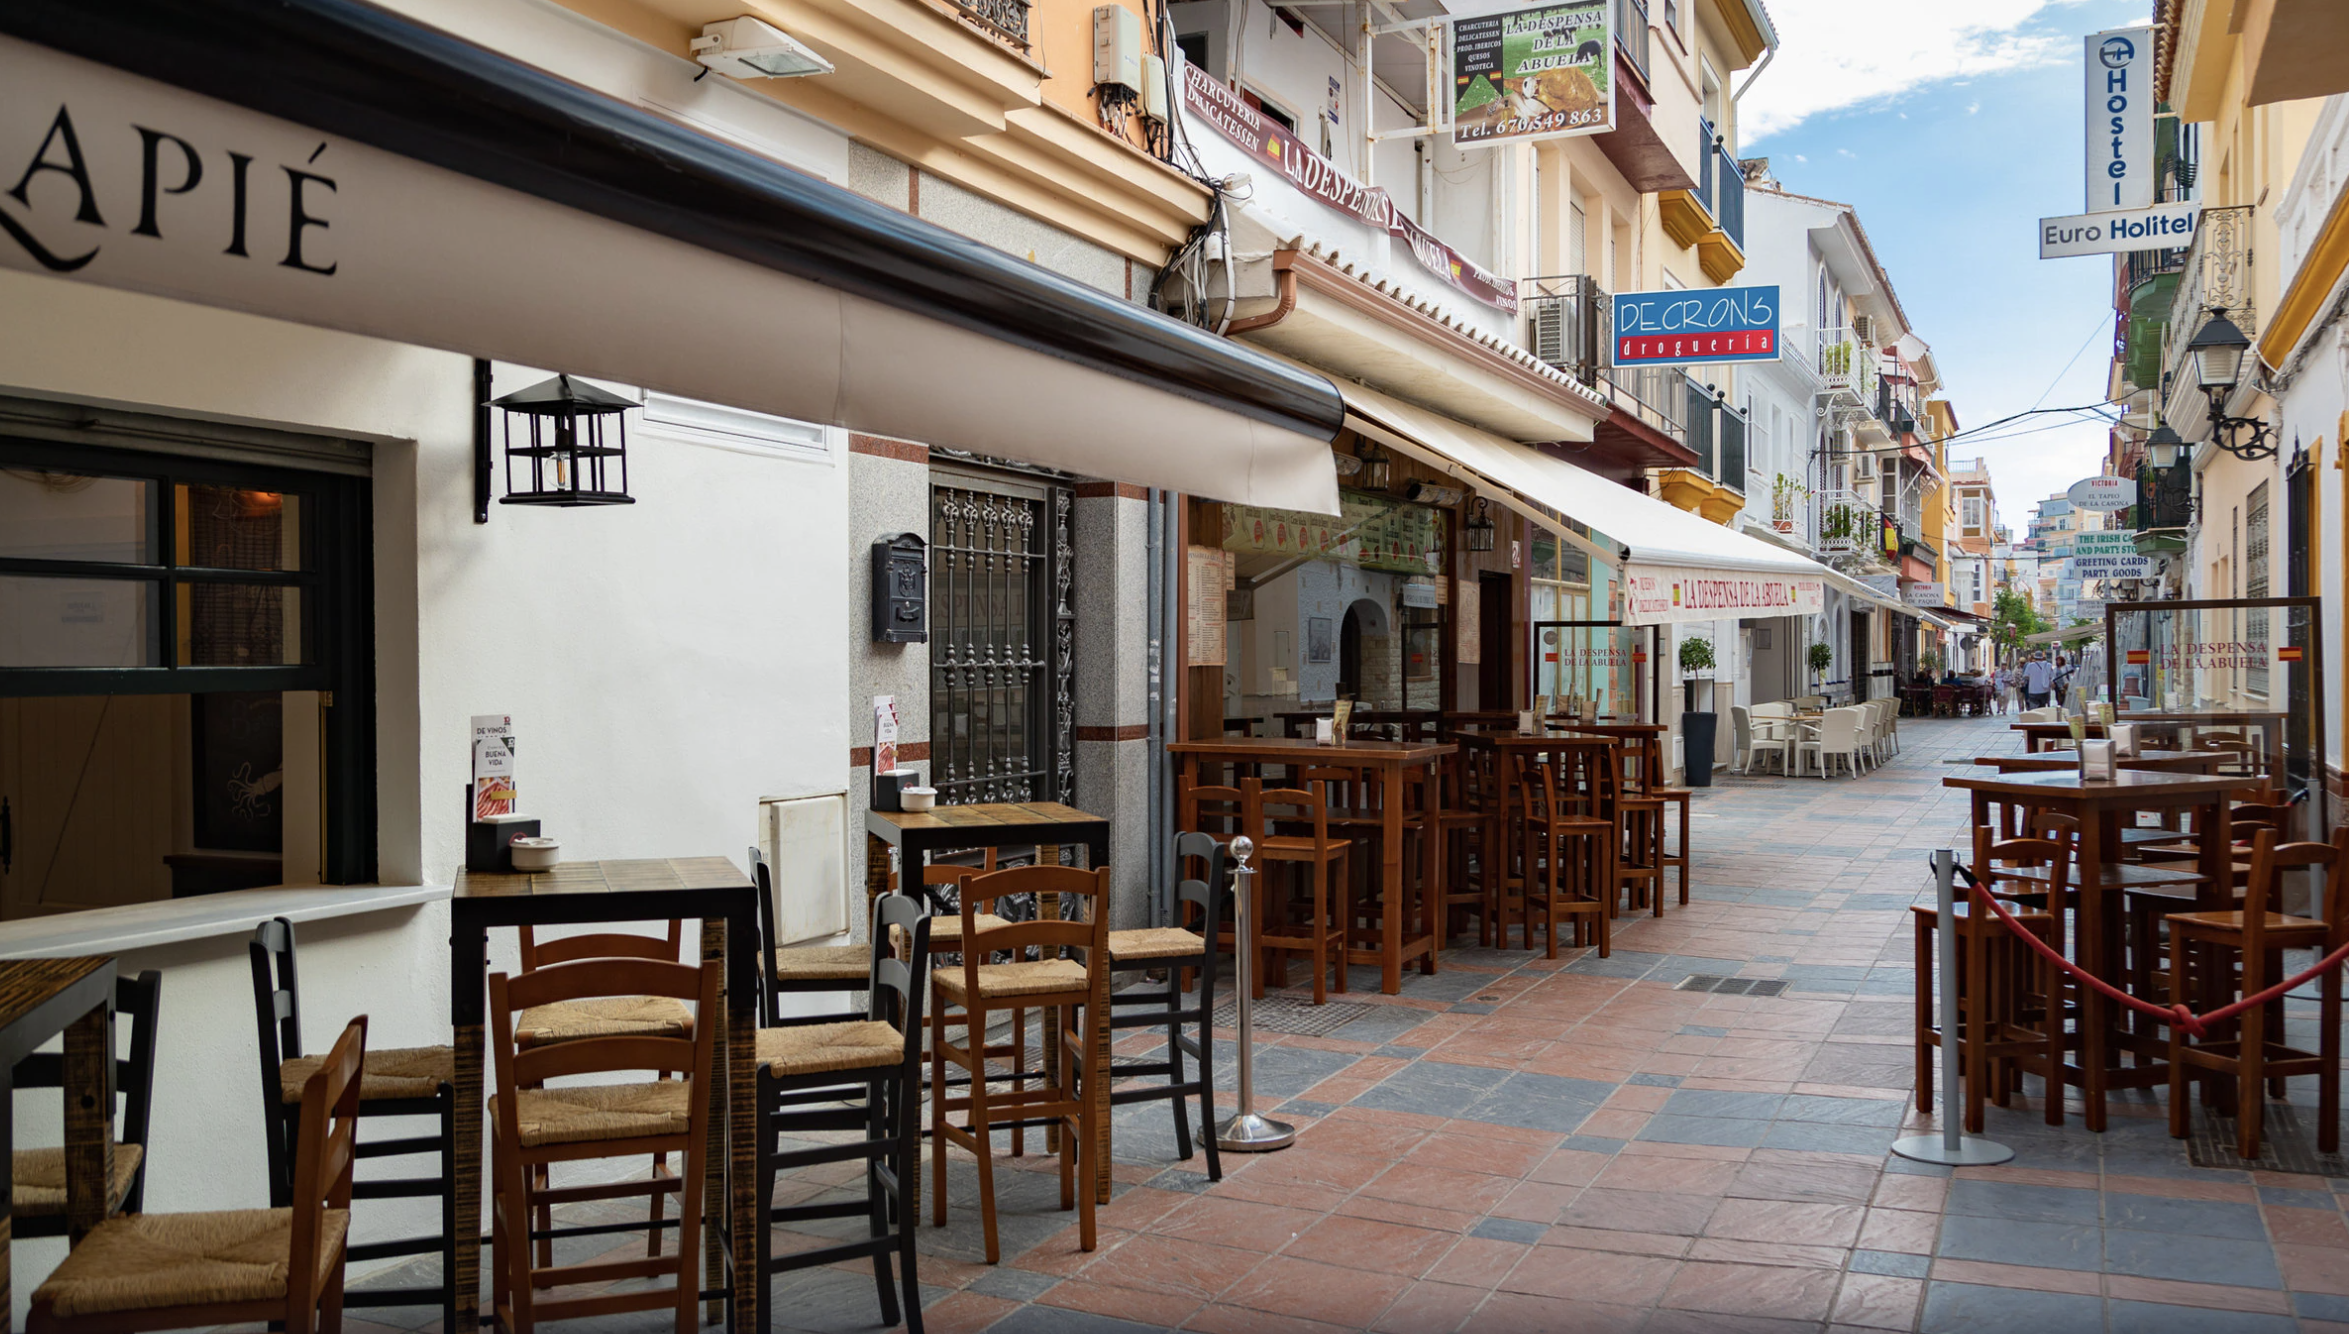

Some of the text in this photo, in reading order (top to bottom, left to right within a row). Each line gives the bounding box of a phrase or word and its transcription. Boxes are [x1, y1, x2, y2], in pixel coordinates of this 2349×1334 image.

[1459, 19, 1499, 32] CHARCUTERIA
[1506, 10, 1602, 35] LA DESPENSA
[1458, 29, 1501, 42] DELICATESSEN
[1533, 34, 1574, 50] DE LA
[1457, 40, 1501, 52] PROD. IBERICOS
[1468, 52, 1490, 62] QUESOS
[1518, 51, 1592, 71] ABUELA
[1465, 62, 1494, 72] VINOTECA
[1184, 65, 1261, 131] CHARCUTERIA
[1187, 84, 1260, 153] DELICATESSEN
[1460, 108, 1602, 138] Tel. 670 549 863
[2107, 68, 2128, 206] Hostel
[1284, 140, 1304, 184] LA
[0, 103, 337, 276] APIÉ
[2045, 212, 2193, 245] Euro Holitel
[1621, 289, 1773, 333] DECRONS
[1623, 333, 1768, 357] droguería
[2091, 479, 2118, 487] VICTORIA
[2079, 534, 2095, 544] THE
[2097, 534, 2120, 543] IRISH
[2076, 546, 2093, 555] AND
[2094, 545, 2120, 554] PARTY
[2076, 556, 2148, 567] GREETING CARDS
[2082, 568, 2142, 578] PARTY GOODS
[1684, 579, 1789, 609] LA DESPENSA DE LA ABUELA
[1564, 648, 1627, 657] LA DESPENSA
[2160, 641, 2267, 655] LA DESPENSA
[1564, 659, 1576, 667] DE
[1591, 658, 1627, 666] ABUELA
[2160, 656, 2267, 670] DE LA ABUELA
[487, 726, 507, 734] VINOS
[485, 750, 507, 758] BUENA
